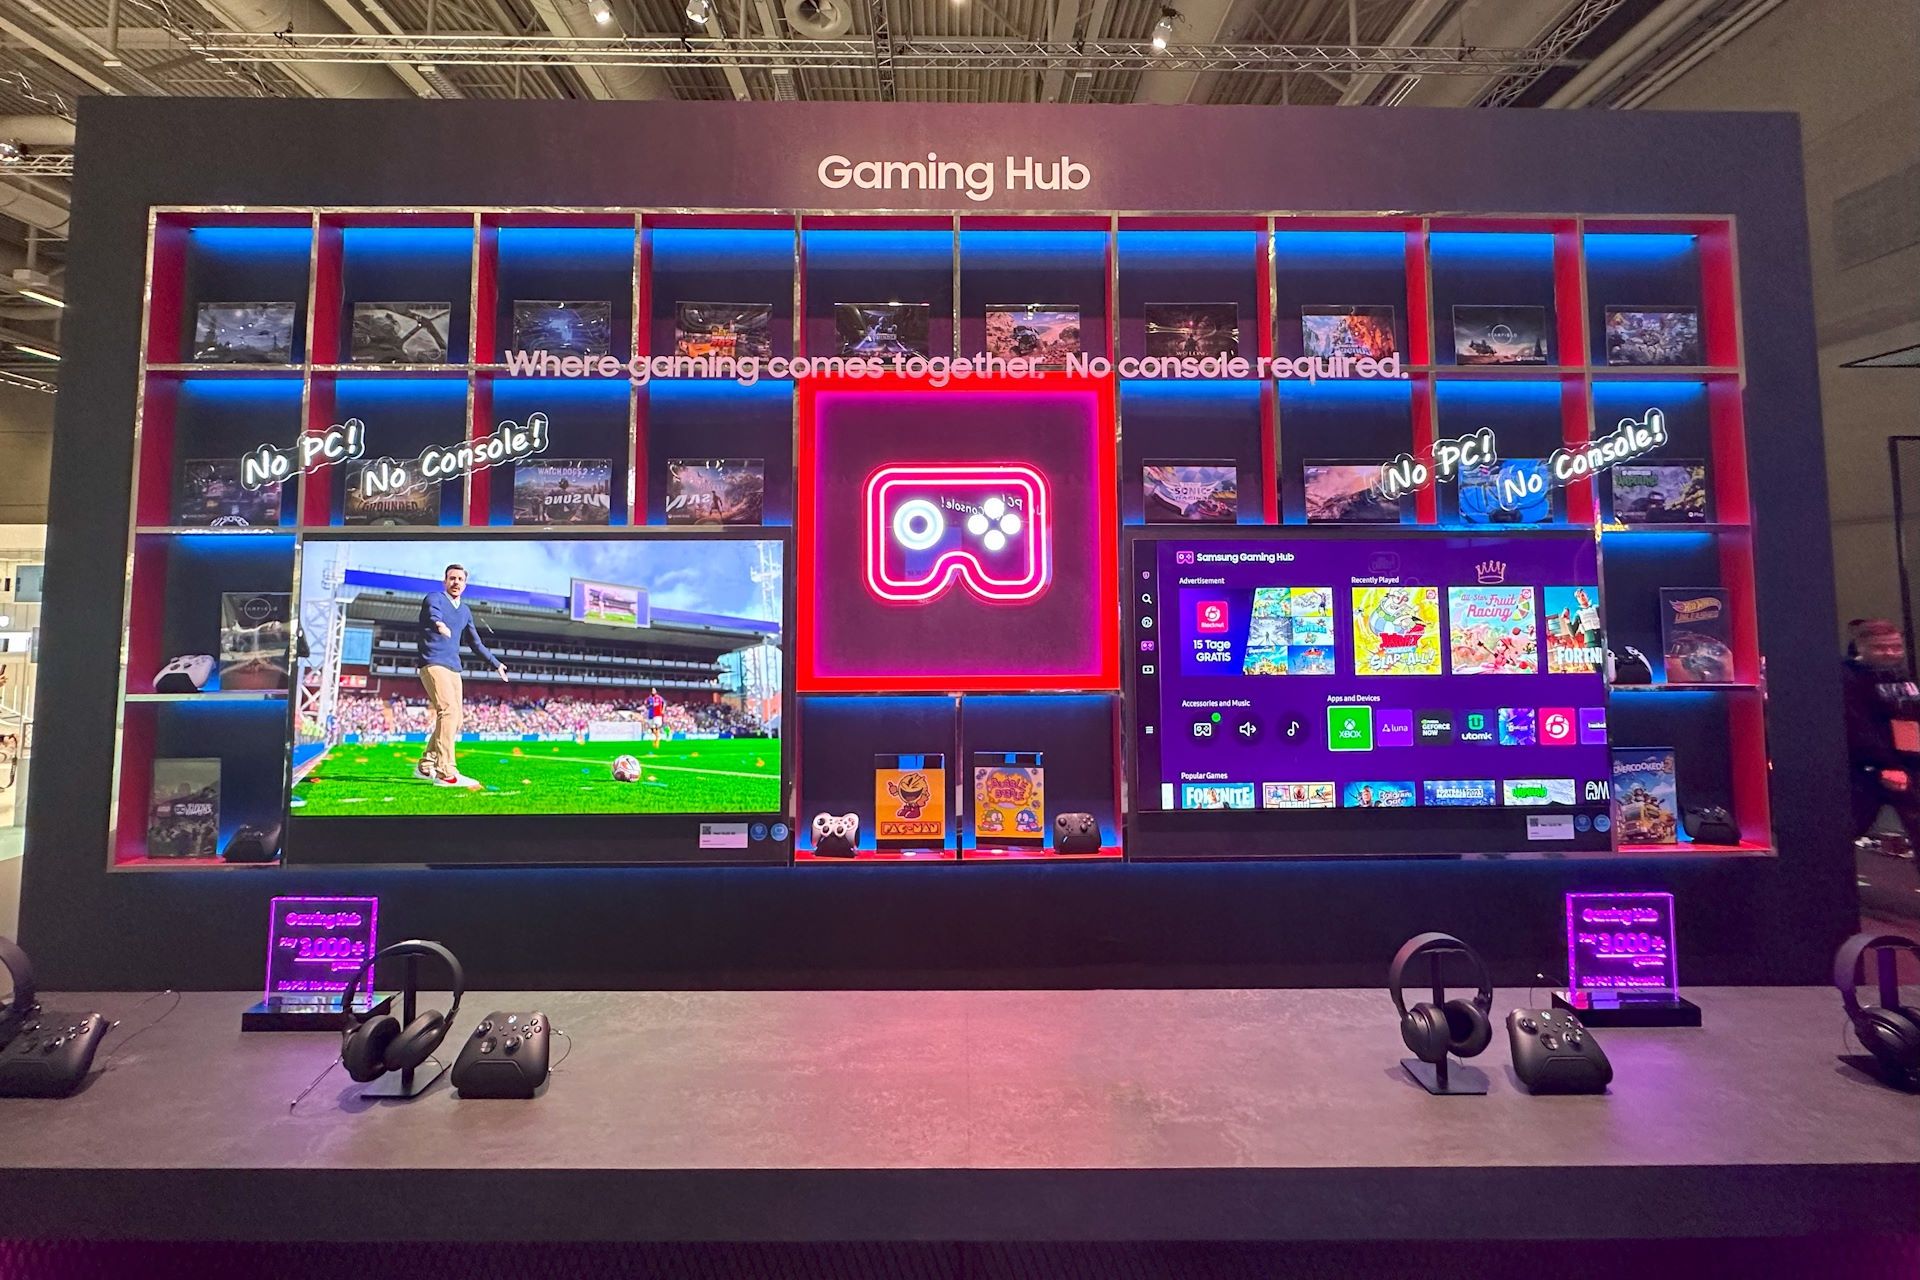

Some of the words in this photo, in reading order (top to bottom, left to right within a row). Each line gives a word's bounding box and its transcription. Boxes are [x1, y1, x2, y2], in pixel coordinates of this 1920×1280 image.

[818, 152, 995, 202] Gaming
[1006, 156, 1091, 190] Hub
[505, 350, 619, 378] Where
[629, 351, 760, 386] gaming
[767, 355, 884, 379] comes
[894, 351, 1044, 387] together.
[1066, 353, 1110, 379] No
[1118, 351, 1249, 379] console
[1257, 351, 1409, 385] required.
[246, 453, 288, 484] No
[304, 425, 356, 466] PC!
[366, 462, 406, 497] No
[422, 419, 541, 477] Console!
[1504, 469, 1542, 503] No
[1555, 414, 1663, 480] Console!
[1388, 459, 1427, 492] No
[1437, 434, 1491, 474] PC!
[1197, 553, 1239, 564] Samsung
[1240, 552, 1275, 564] Gaming
[1276, 553, 1294, 562] Hub
[1179, 577, 1225, 585] Advertisement
[1351, 576, 1378, 585] Recently
[1379, 576, 1399, 585] Played
[1486, 594, 1516, 606] Fruit
[1467, 604, 1512, 622] Racing
[1193, 639, 1203, 649] 15
[1205, 639, 1231, 652] Tage
[1196, 652, 1231, 662] GRATIS
[1327, 695, 1343, 703] Apps
[1339, 730, 1362, 738] XBOX
[1391, 724, 1408, 732] luna
[1181, 772, 1205, 781] Popular
[1206, 772, 1228, 780] Games
[883, 823, 938, 835] PAC-MAN
[286, 912, 335, 929] Gaming
[336, 912, 361, 926] Hub
[1583, 907, 1632, 925] Gaming
